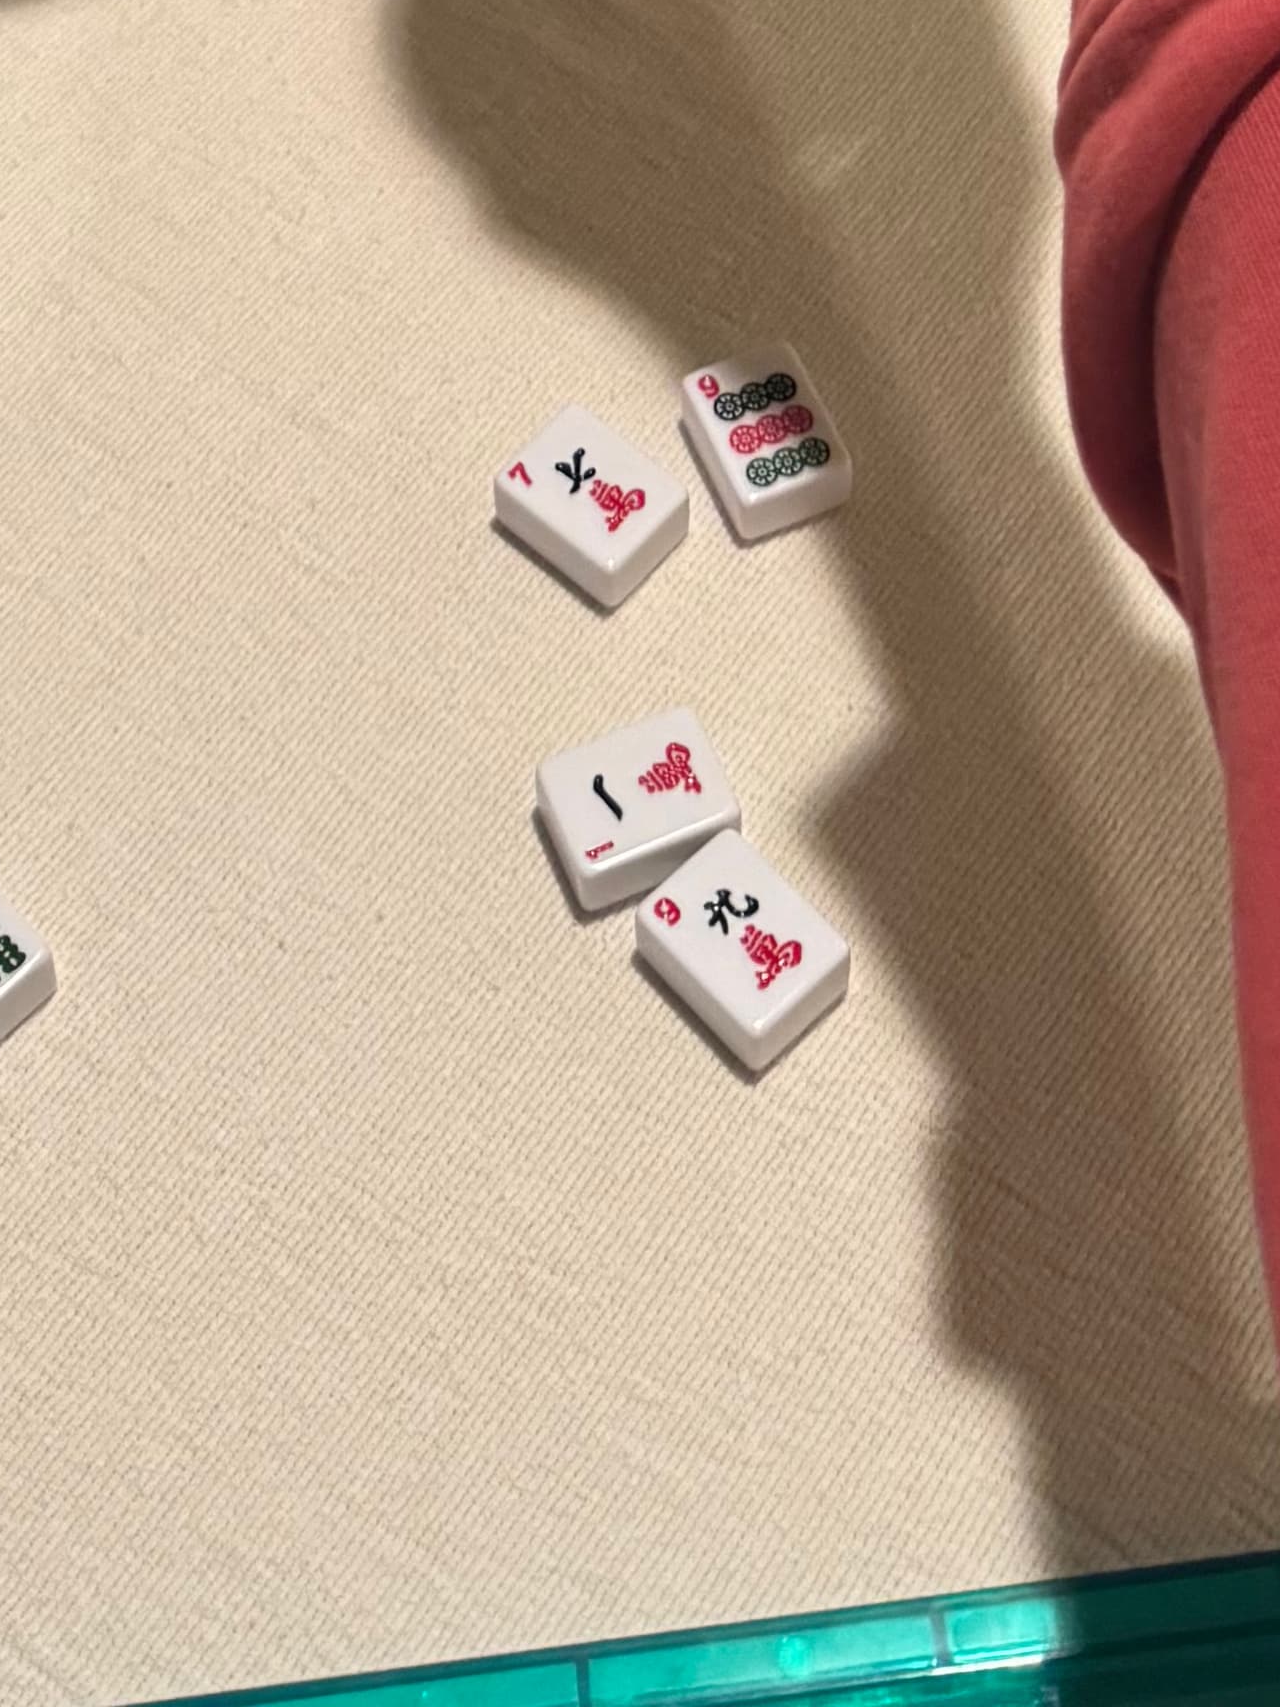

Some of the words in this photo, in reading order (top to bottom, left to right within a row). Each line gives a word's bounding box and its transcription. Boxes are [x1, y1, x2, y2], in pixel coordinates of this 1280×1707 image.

[697, 375, 721, 400] 9
[507, 461, 533, 487] 7
[585, 842, 614, 860] 1
[653, 897, 682, 927] 9
